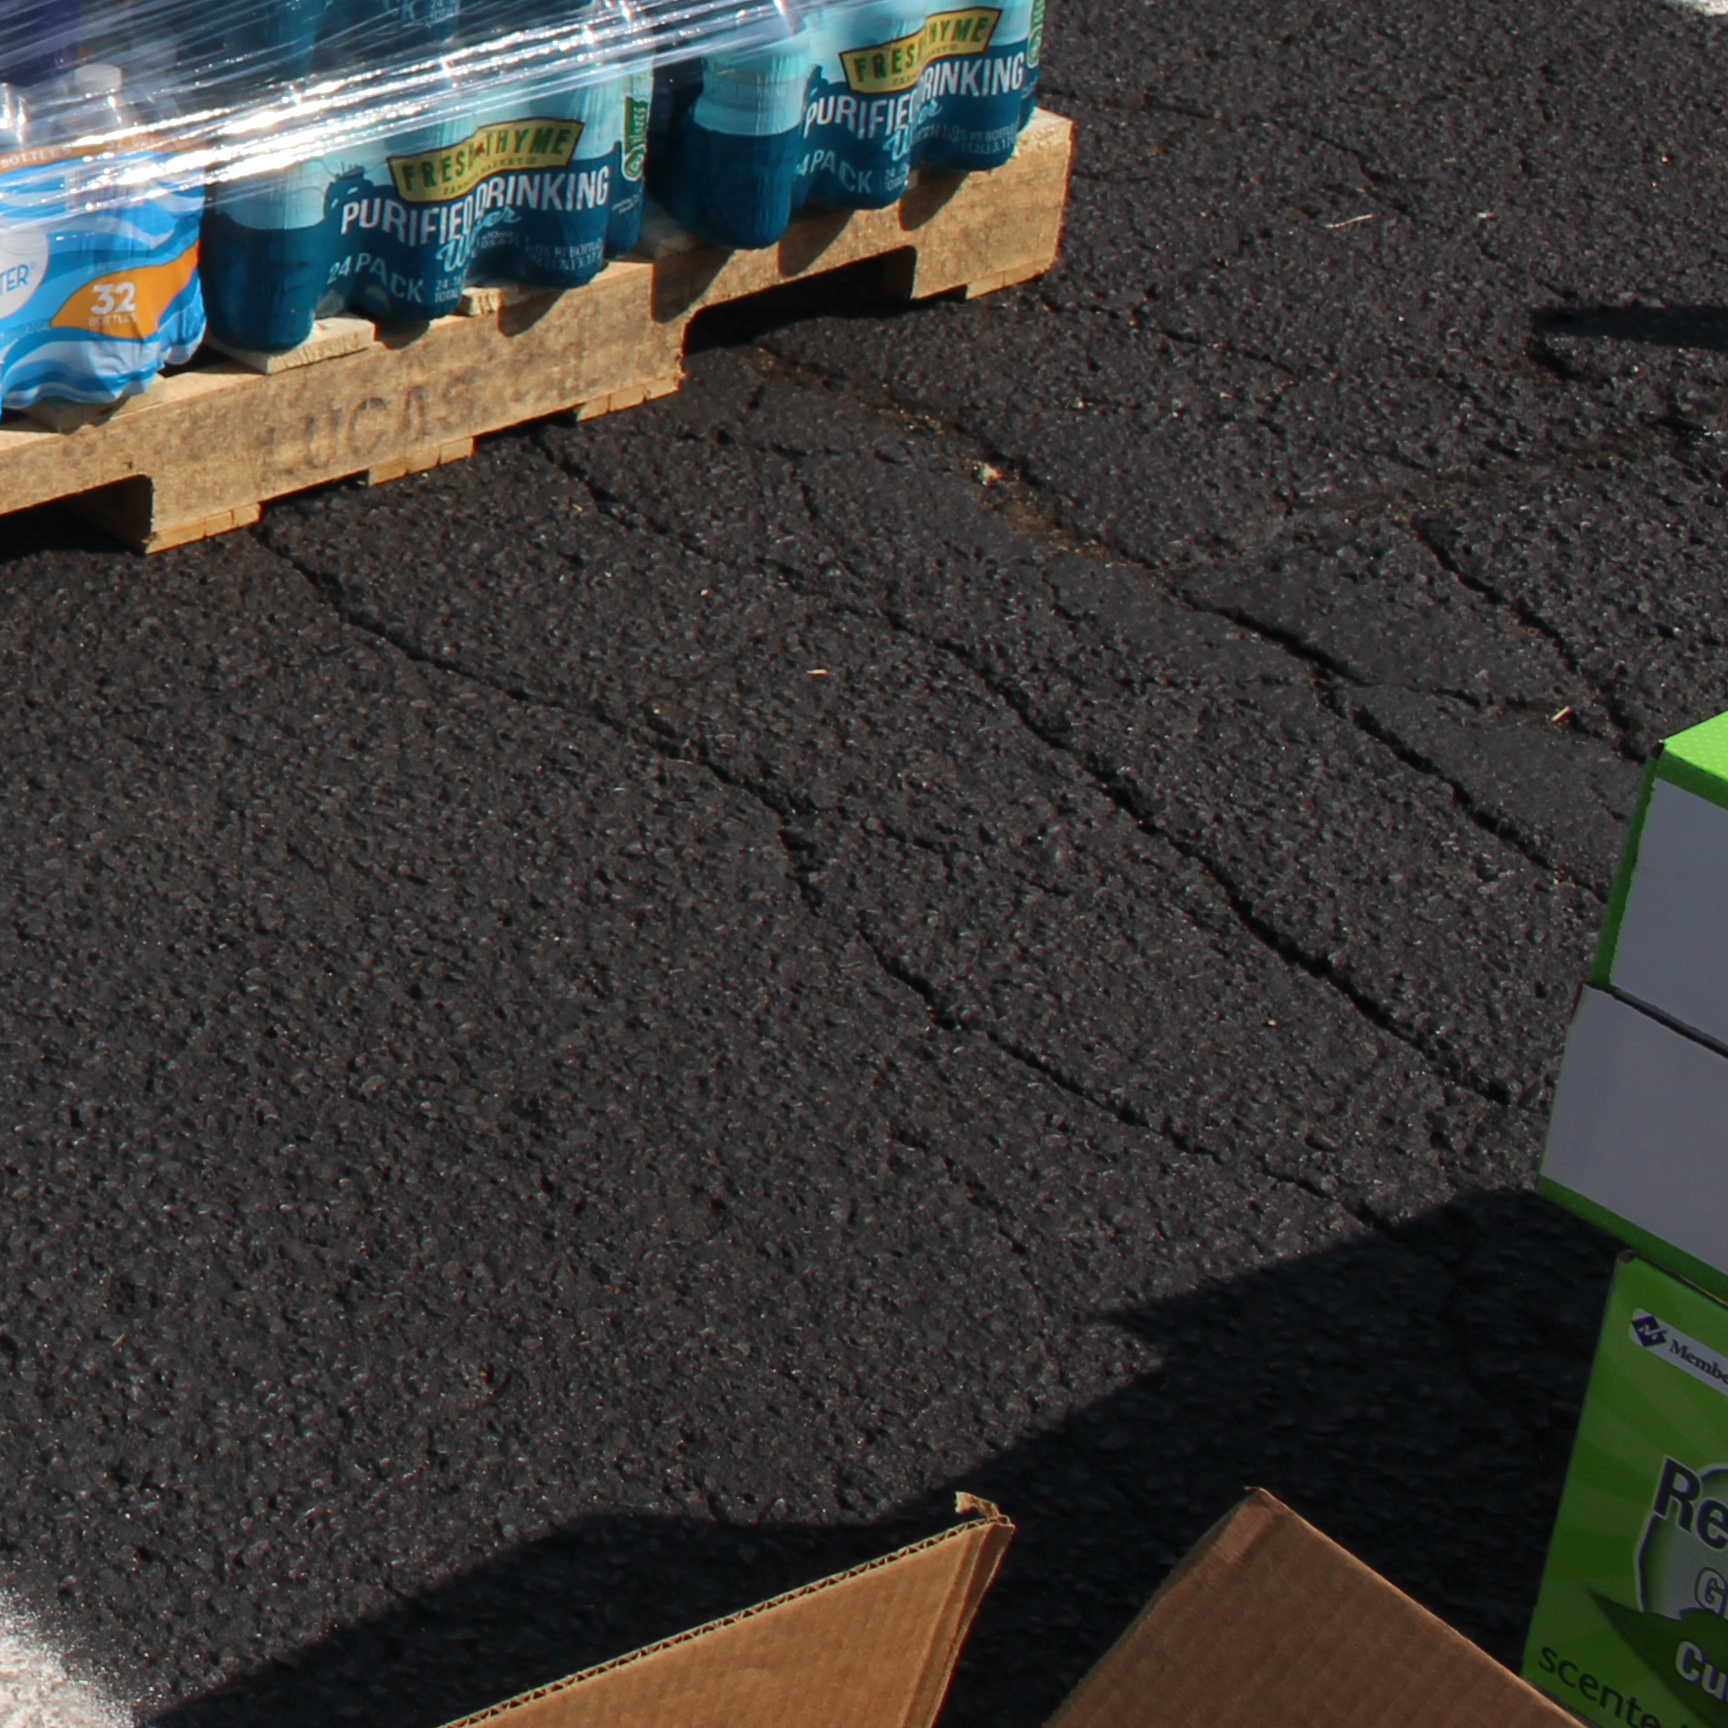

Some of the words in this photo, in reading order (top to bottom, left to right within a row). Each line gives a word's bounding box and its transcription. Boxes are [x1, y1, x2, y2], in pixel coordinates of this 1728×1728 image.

[484, 127, 574, 157] THYME
[810, 148, 873, 195] PACK
[340, 195, 474, 248] PURIFIED
[474, 164, 612, 219] DRINKING
[328, 253, 352, 286] 24
[354, 251, 426, 304] PACK
[90, 281, 137, 316] 32
[87, 311, 139, 328] BOTTLES
